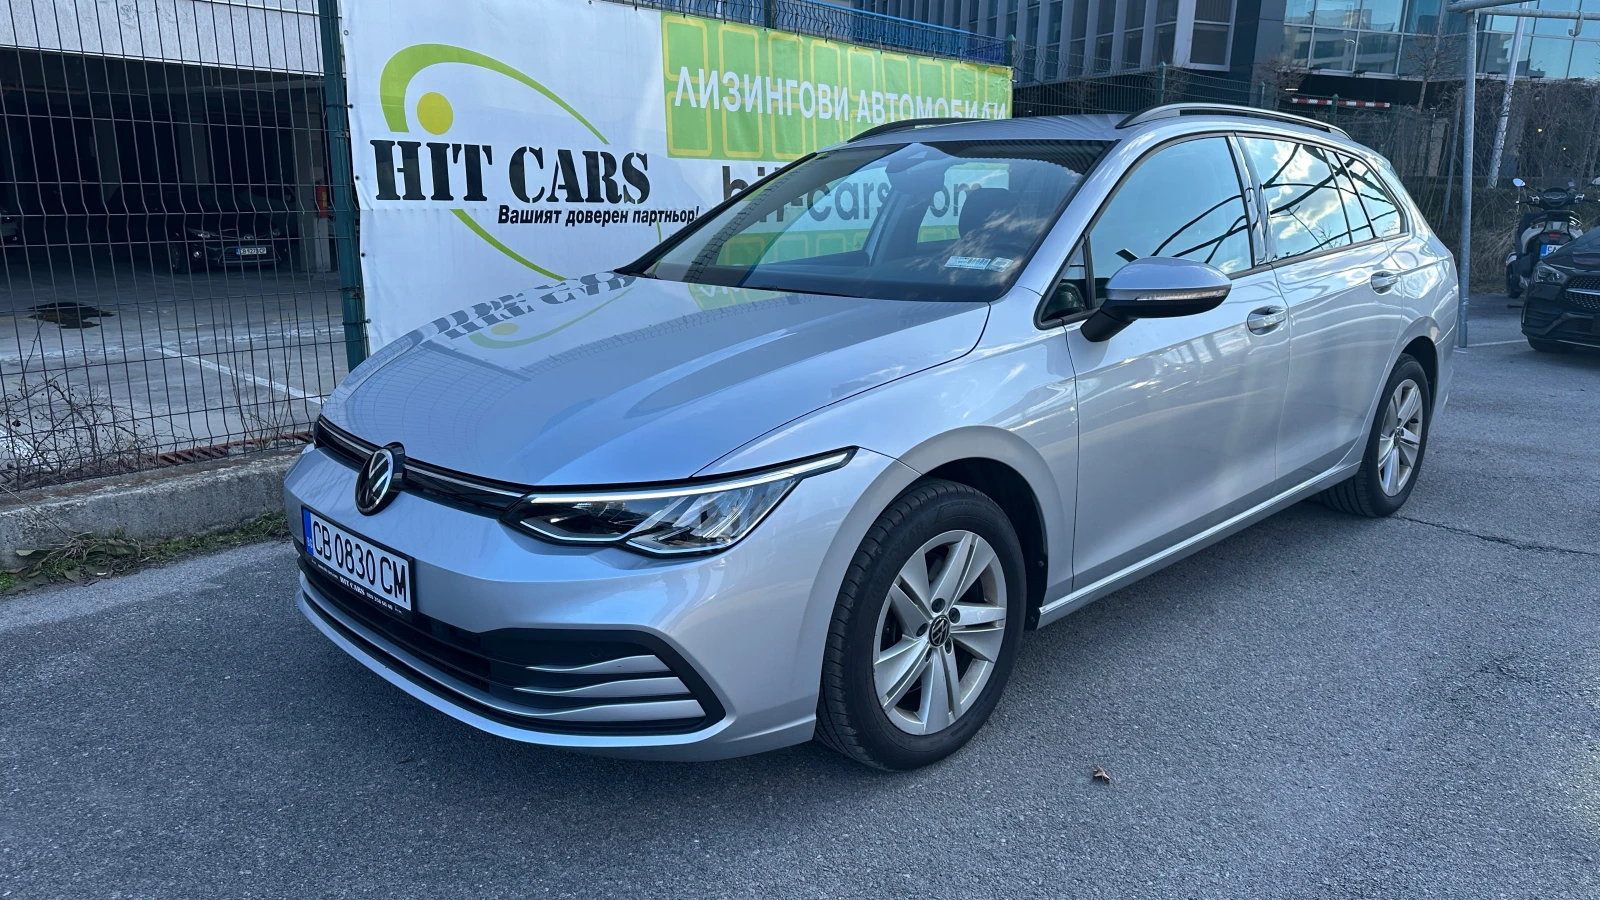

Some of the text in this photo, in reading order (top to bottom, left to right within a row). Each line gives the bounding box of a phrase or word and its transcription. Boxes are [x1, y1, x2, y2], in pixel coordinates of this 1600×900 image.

[674, 66, 849, 122] ЛИЗИНГОВИ
[370, 140, 651, 204] HIT CARS
[498, 204, 700, 227] Вашият доверен партньор!
[313, 520, 332, 561] CB
[334, 533, 376, 586] 0830
[380, 556, 407, 602] CM
